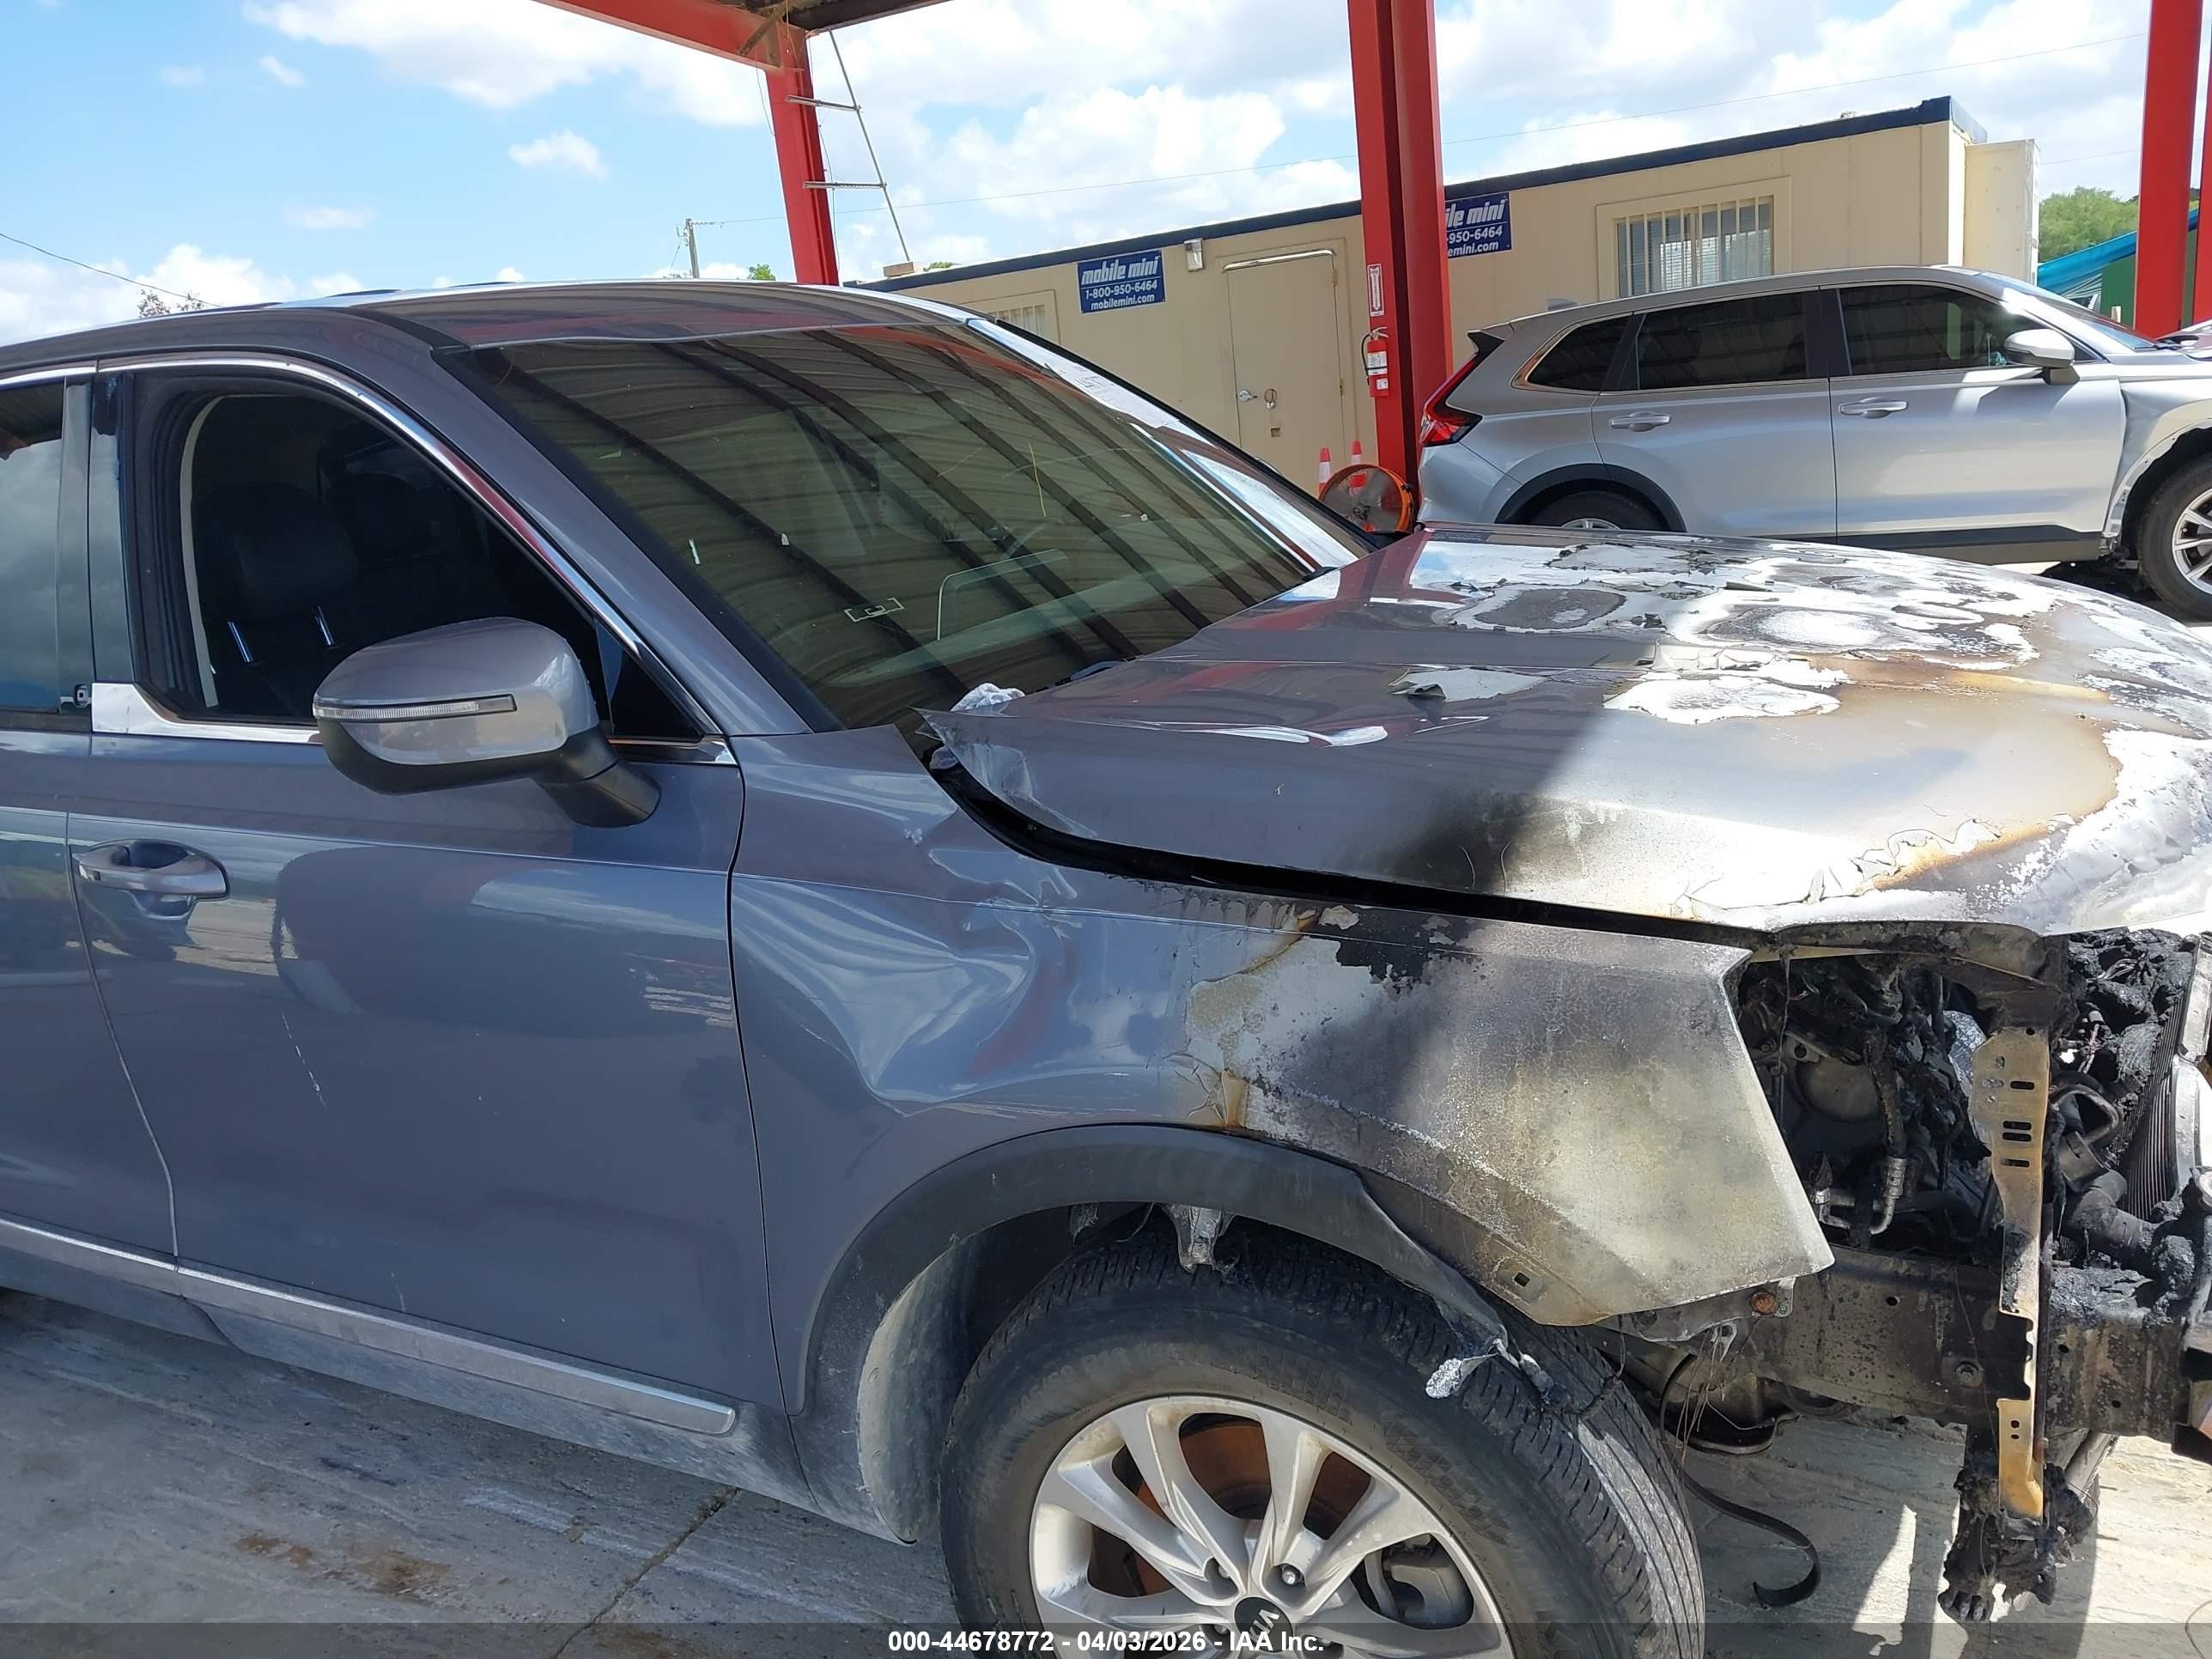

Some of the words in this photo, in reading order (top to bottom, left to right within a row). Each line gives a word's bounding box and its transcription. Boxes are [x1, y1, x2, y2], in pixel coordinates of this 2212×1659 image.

[1445, 204, 1465, 228] ile
[1466, 199, 1505, 225] mini
[1446, 225, 1503, 244] -950-6464
[1448, 241, 1499, 257] emini.com
[1081, 258, 1127, 285] mobile
[1127, 256, 1160, 278] mini
[1085, 279, 1158, 300] 1-800-950-6464
[1091, 294, 1155, 311] mobilemini.com
